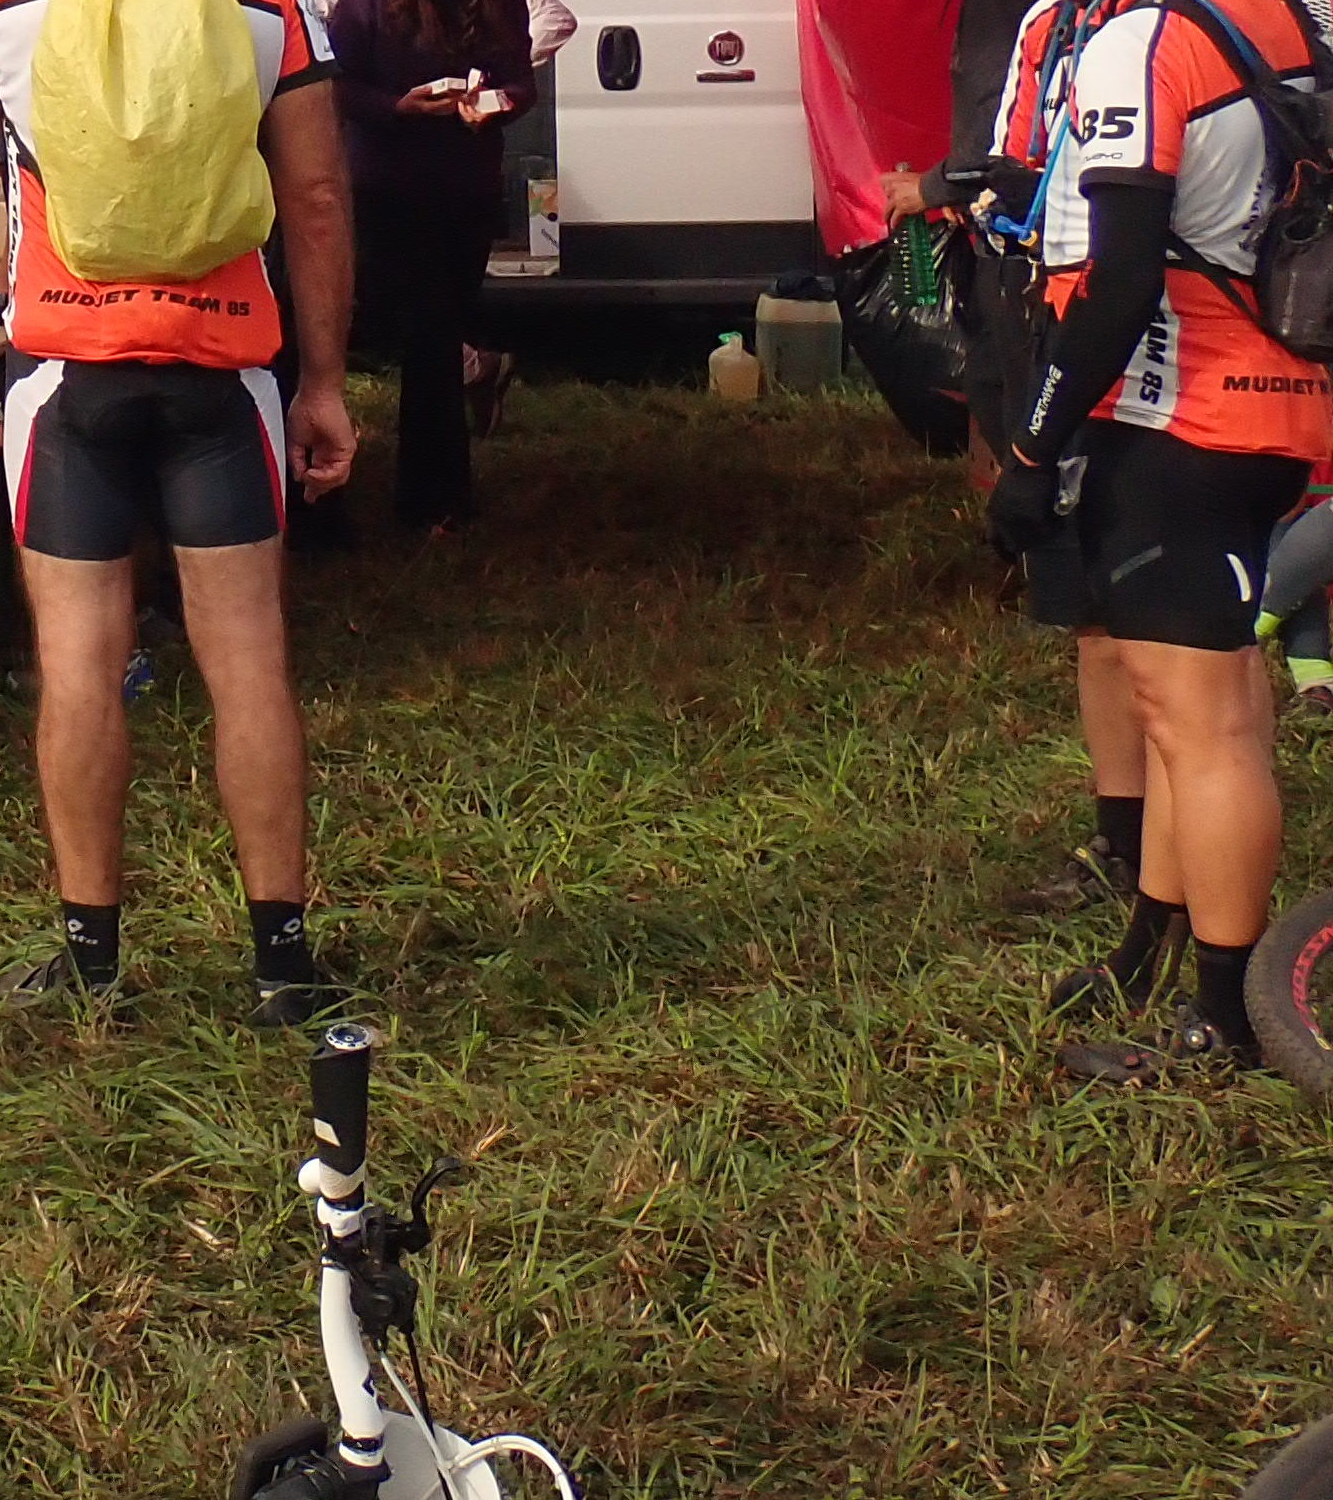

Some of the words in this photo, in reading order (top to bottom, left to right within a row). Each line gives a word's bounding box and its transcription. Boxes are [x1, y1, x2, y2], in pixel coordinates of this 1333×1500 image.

[1083, 106, 1140, 145] 85
[150, 289, 221, 314] TEAM
[226, 300, 251, 318] 85
[1139, 370, 1164, 406] 85
